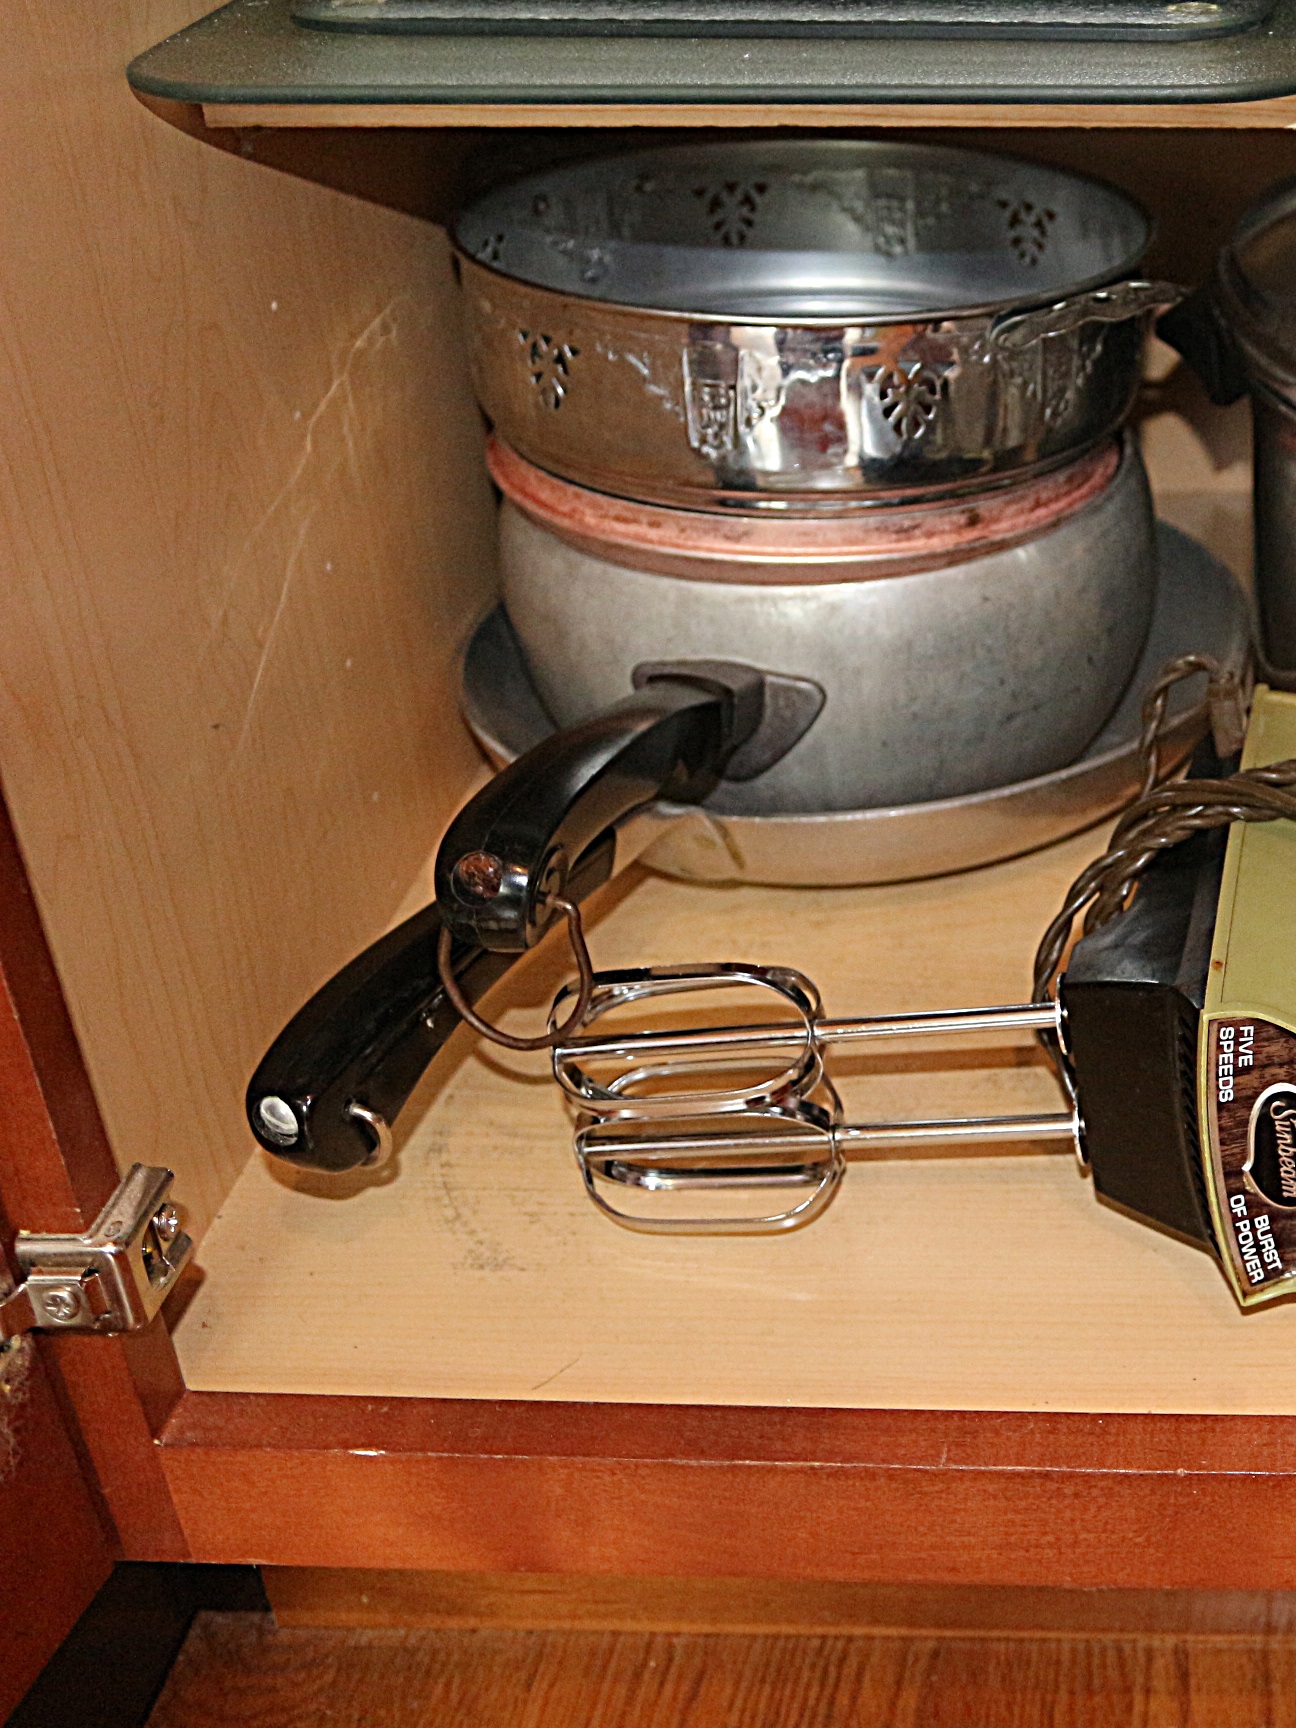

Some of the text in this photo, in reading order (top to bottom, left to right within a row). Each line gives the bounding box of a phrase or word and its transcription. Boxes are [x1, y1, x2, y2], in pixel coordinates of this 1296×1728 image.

[1218, 1026, 1235, 1103] SPEEDS
[1238, 1025, 1254, 1067] FIVE
[1229, 1194, 1265, 1284] OF POWER
[1253, 1214, 1283, 1271] BURST
